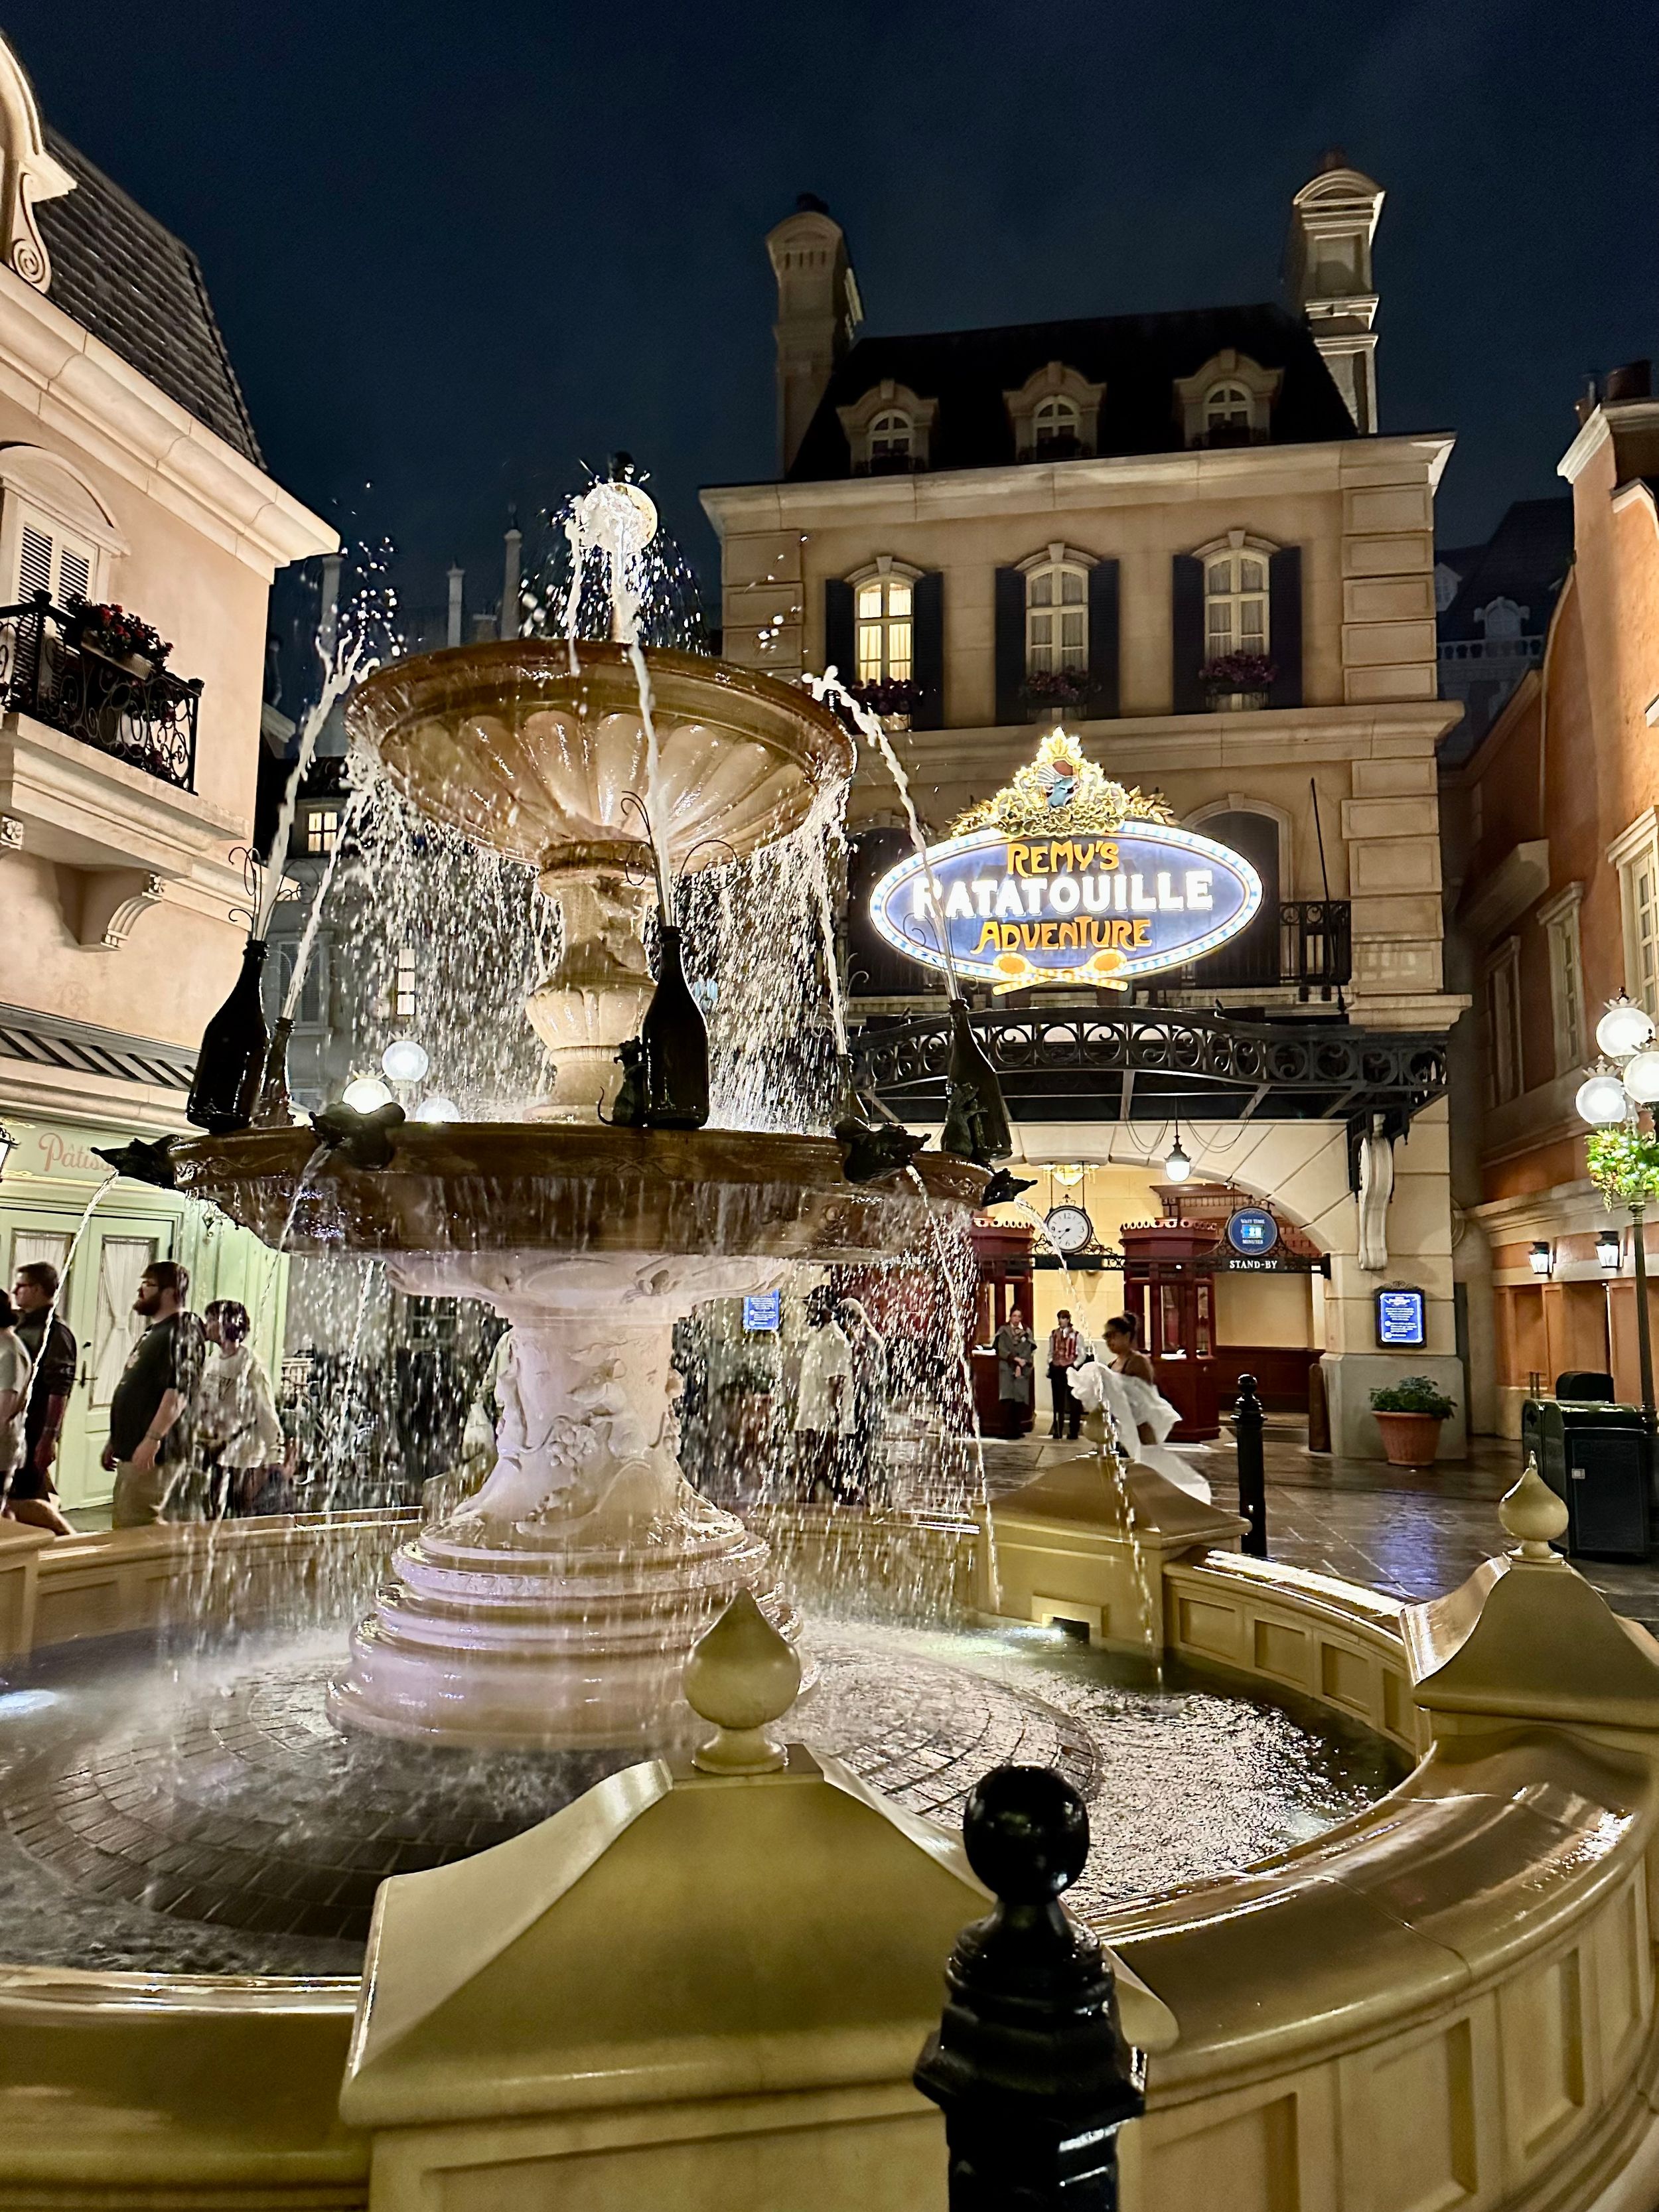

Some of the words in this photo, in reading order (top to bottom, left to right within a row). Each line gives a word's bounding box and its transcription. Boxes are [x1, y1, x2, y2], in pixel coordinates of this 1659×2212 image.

[1007, 840, 1120, 878] REMY'S
[912, 869, 1214, 921] RATATOUILLE
[970, 915, 1153, 955] ADVENTURE
[1229, 1260, 1278, 1269] STAND-BY
